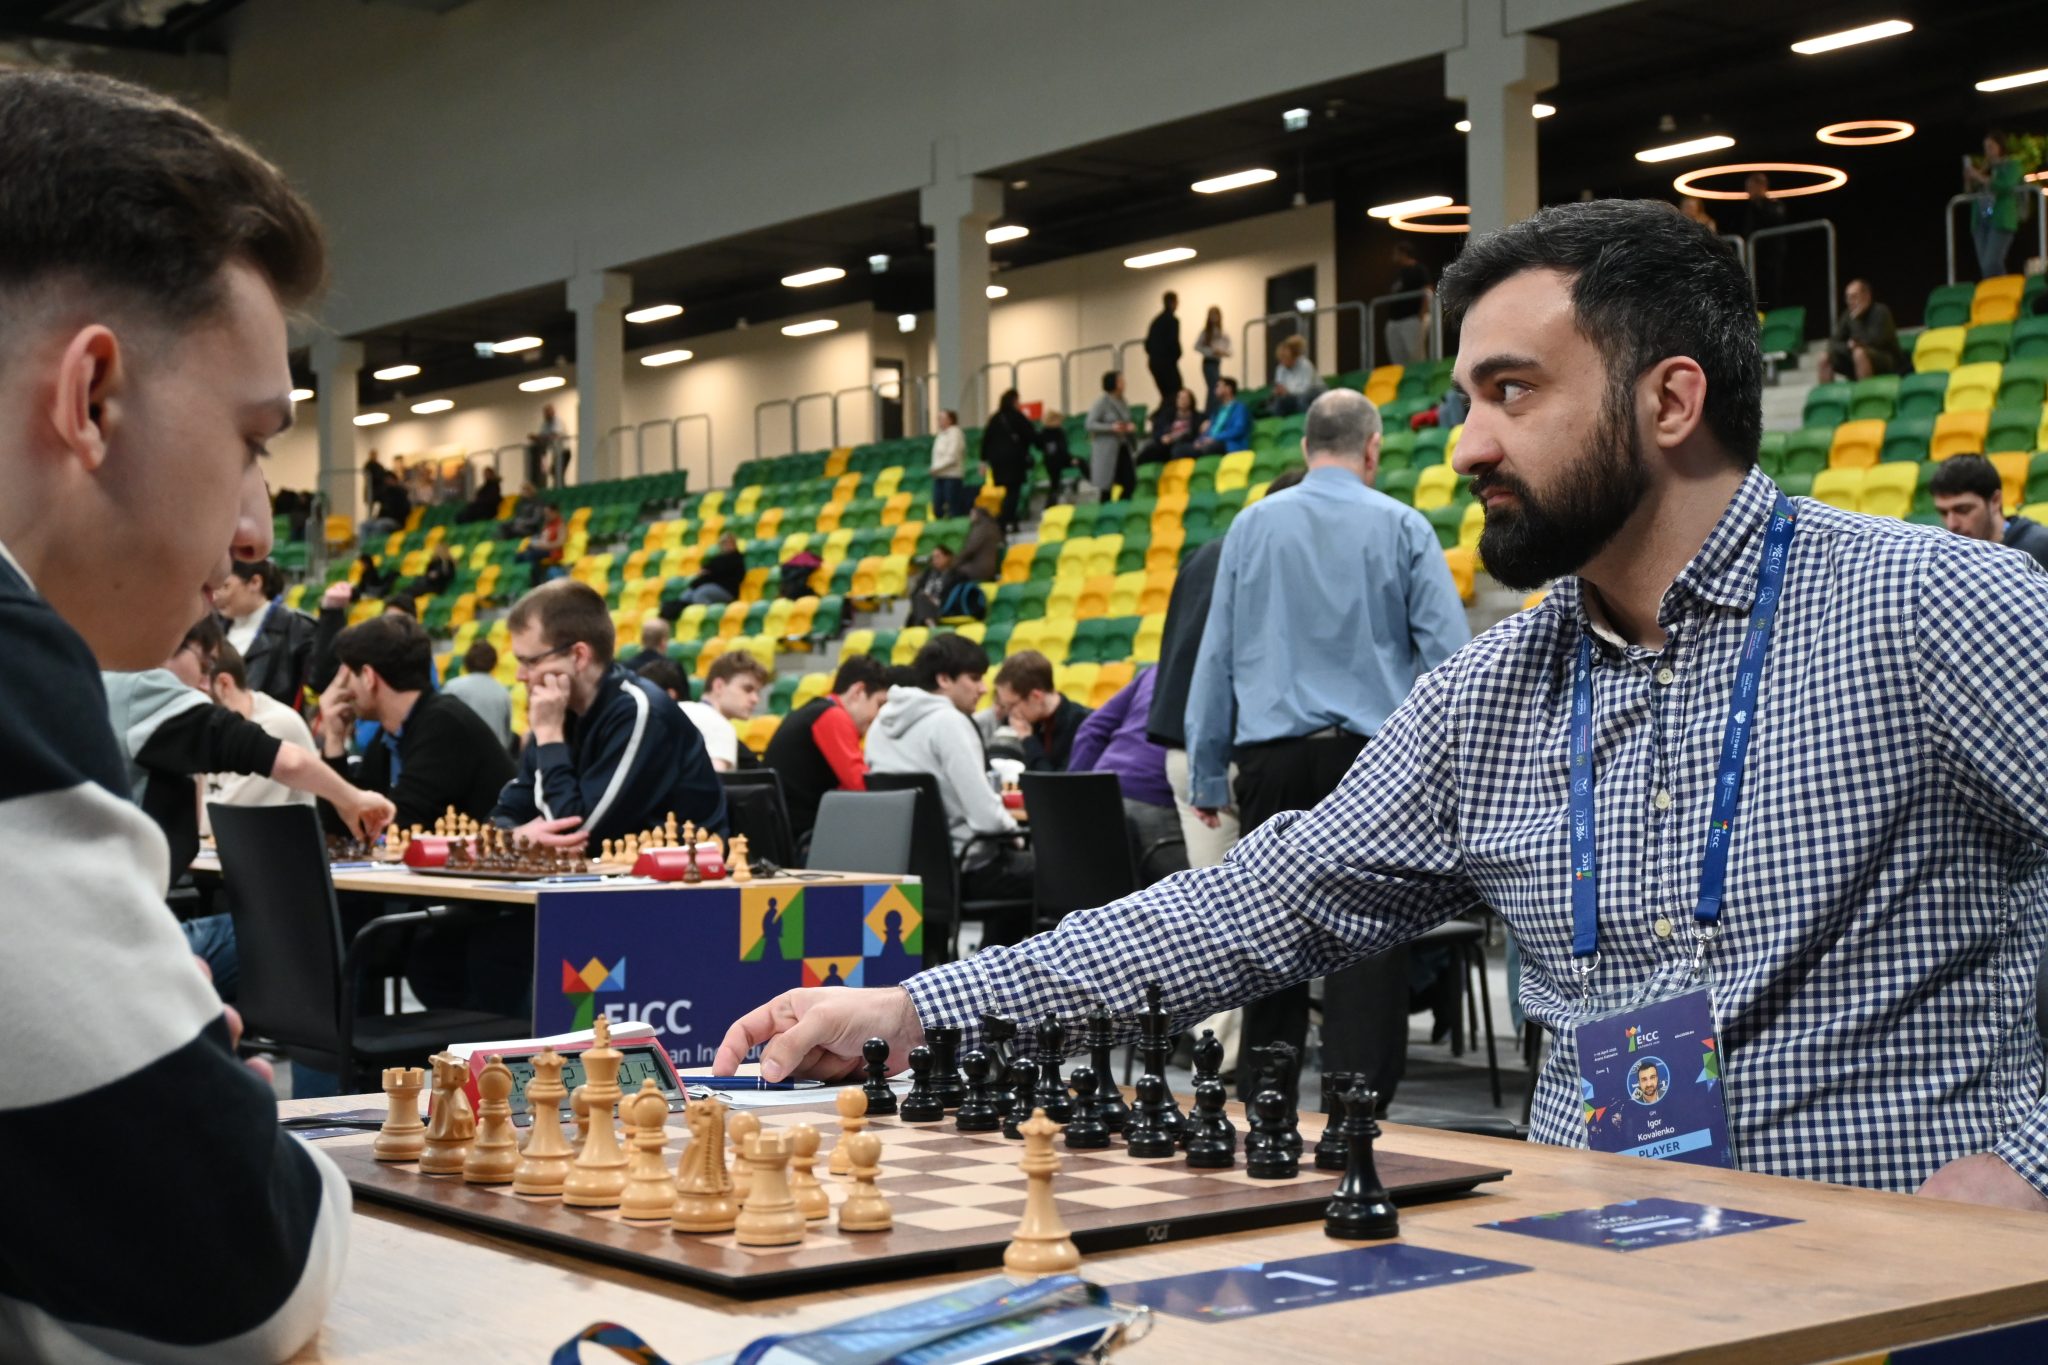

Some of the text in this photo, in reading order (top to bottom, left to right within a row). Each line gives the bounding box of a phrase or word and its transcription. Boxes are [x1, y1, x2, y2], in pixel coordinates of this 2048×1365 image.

[1774, 517, 1786, 533] EICC
[1712, 828, 1720, 849] EICC
[1581, 852, 1589, 871] EICC
[1636, 1030, 1659, 1045] EICC
[1647, 1118, 1662, 1129] Igor
[1637, 1126, 1675, 1142] Kovalenko
[1638, 1141, 1680, 1158] PLAYER
